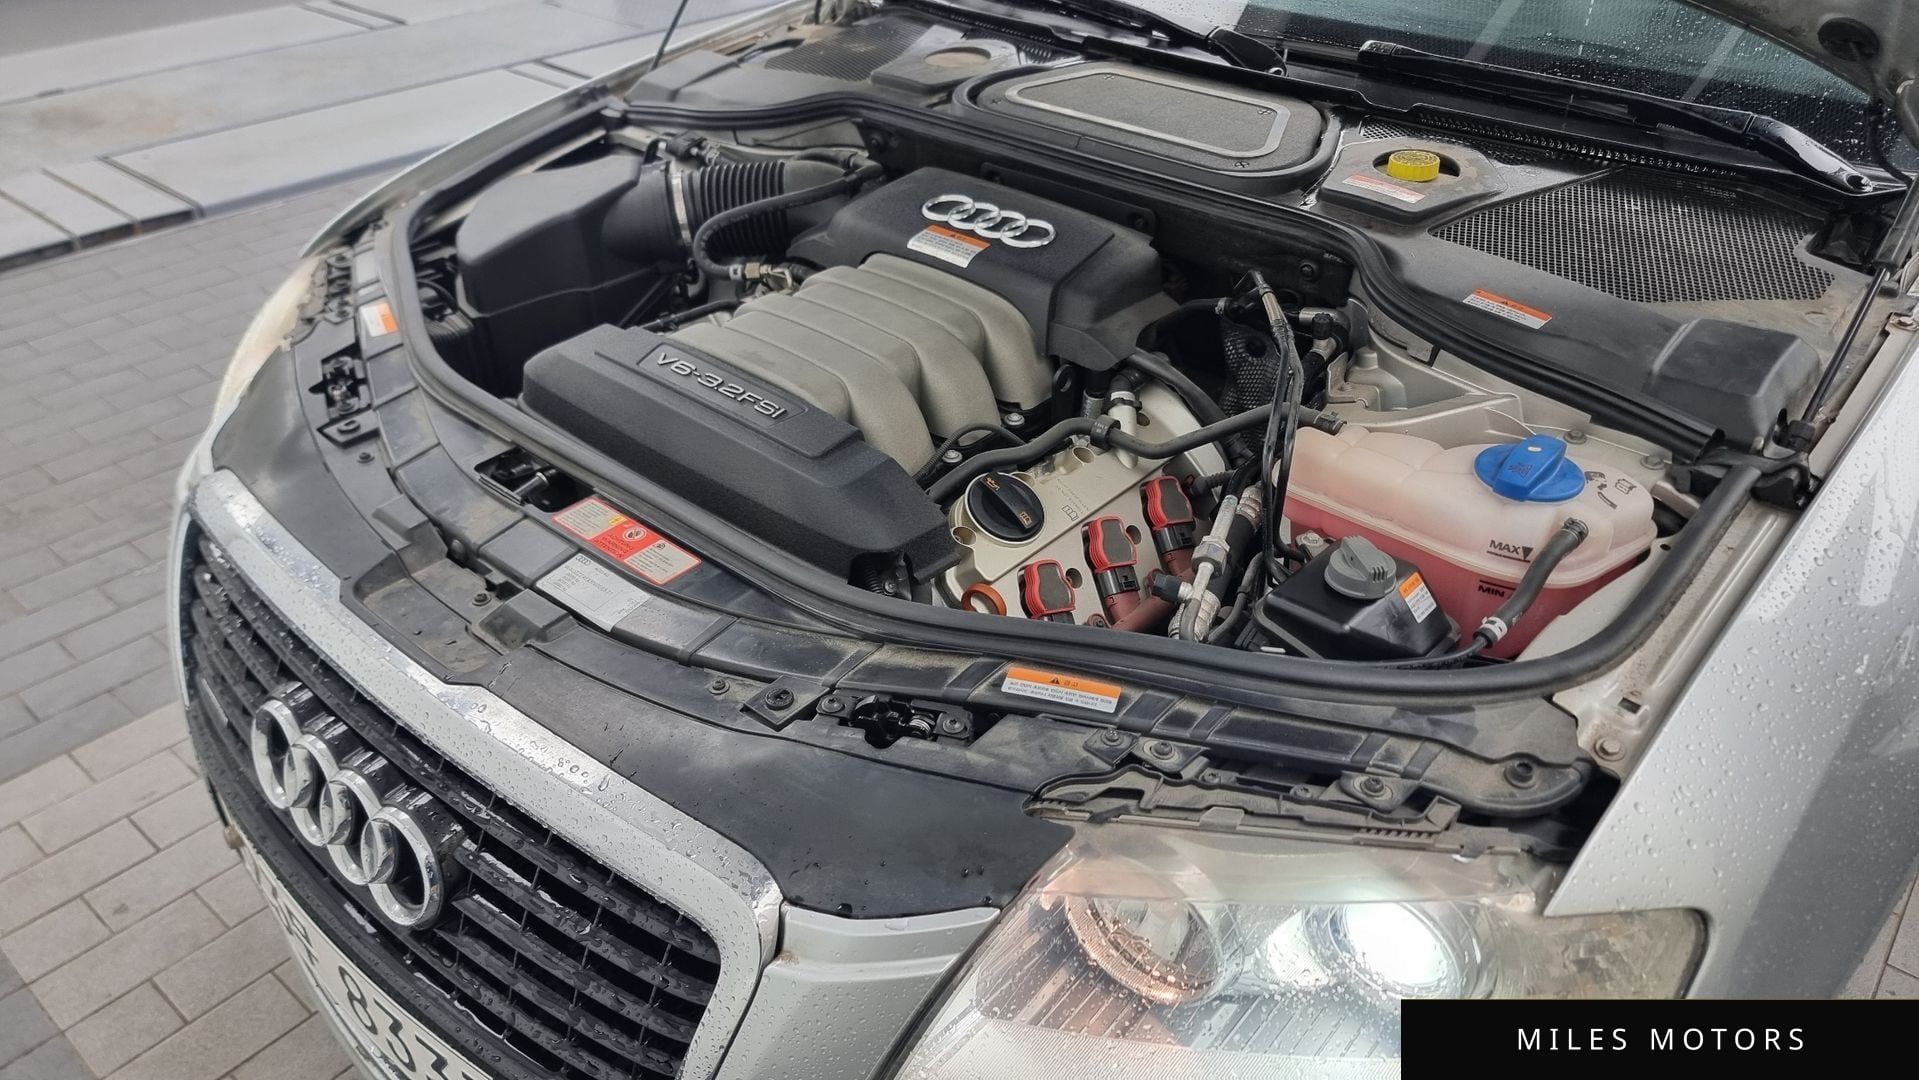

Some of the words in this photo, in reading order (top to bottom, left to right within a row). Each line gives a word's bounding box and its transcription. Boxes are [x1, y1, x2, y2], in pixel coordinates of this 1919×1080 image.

[656, 352, 787, 419] V6-3.2FSI
[1489, 539, 1521, 555] MAX
[1477, 584, 1505, 598] MIN
[338, 965, 472, 1080] 833
